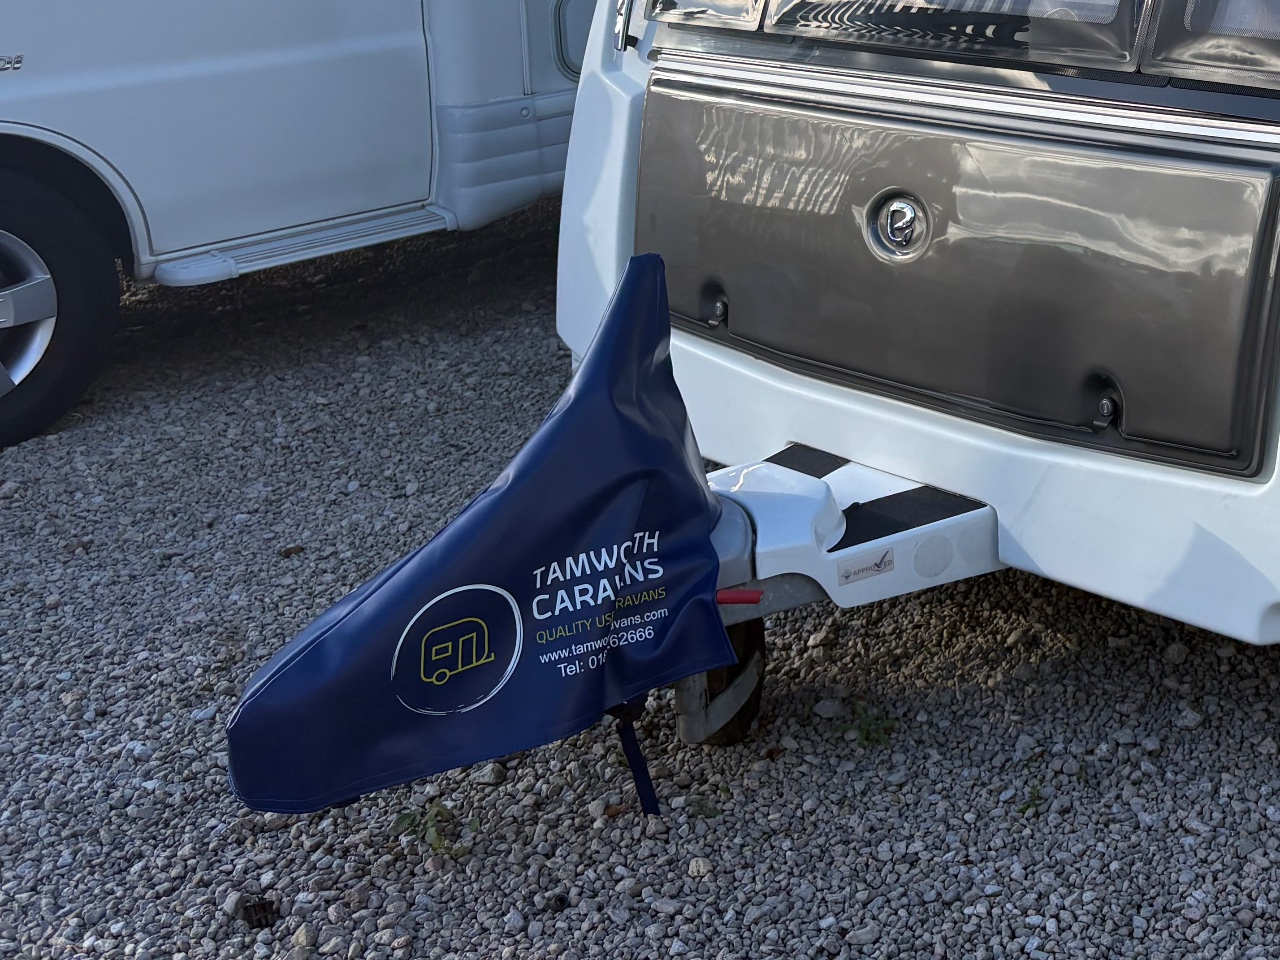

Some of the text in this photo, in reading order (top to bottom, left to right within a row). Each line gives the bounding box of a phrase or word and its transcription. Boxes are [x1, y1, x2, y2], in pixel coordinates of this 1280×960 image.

[532, 531, 660, 589] TAMWOTH
[532, 558, 664, 620] CARANS
[536, 617, 592, 644] QUALITY
[557, 660, 585, 678] Tel:
